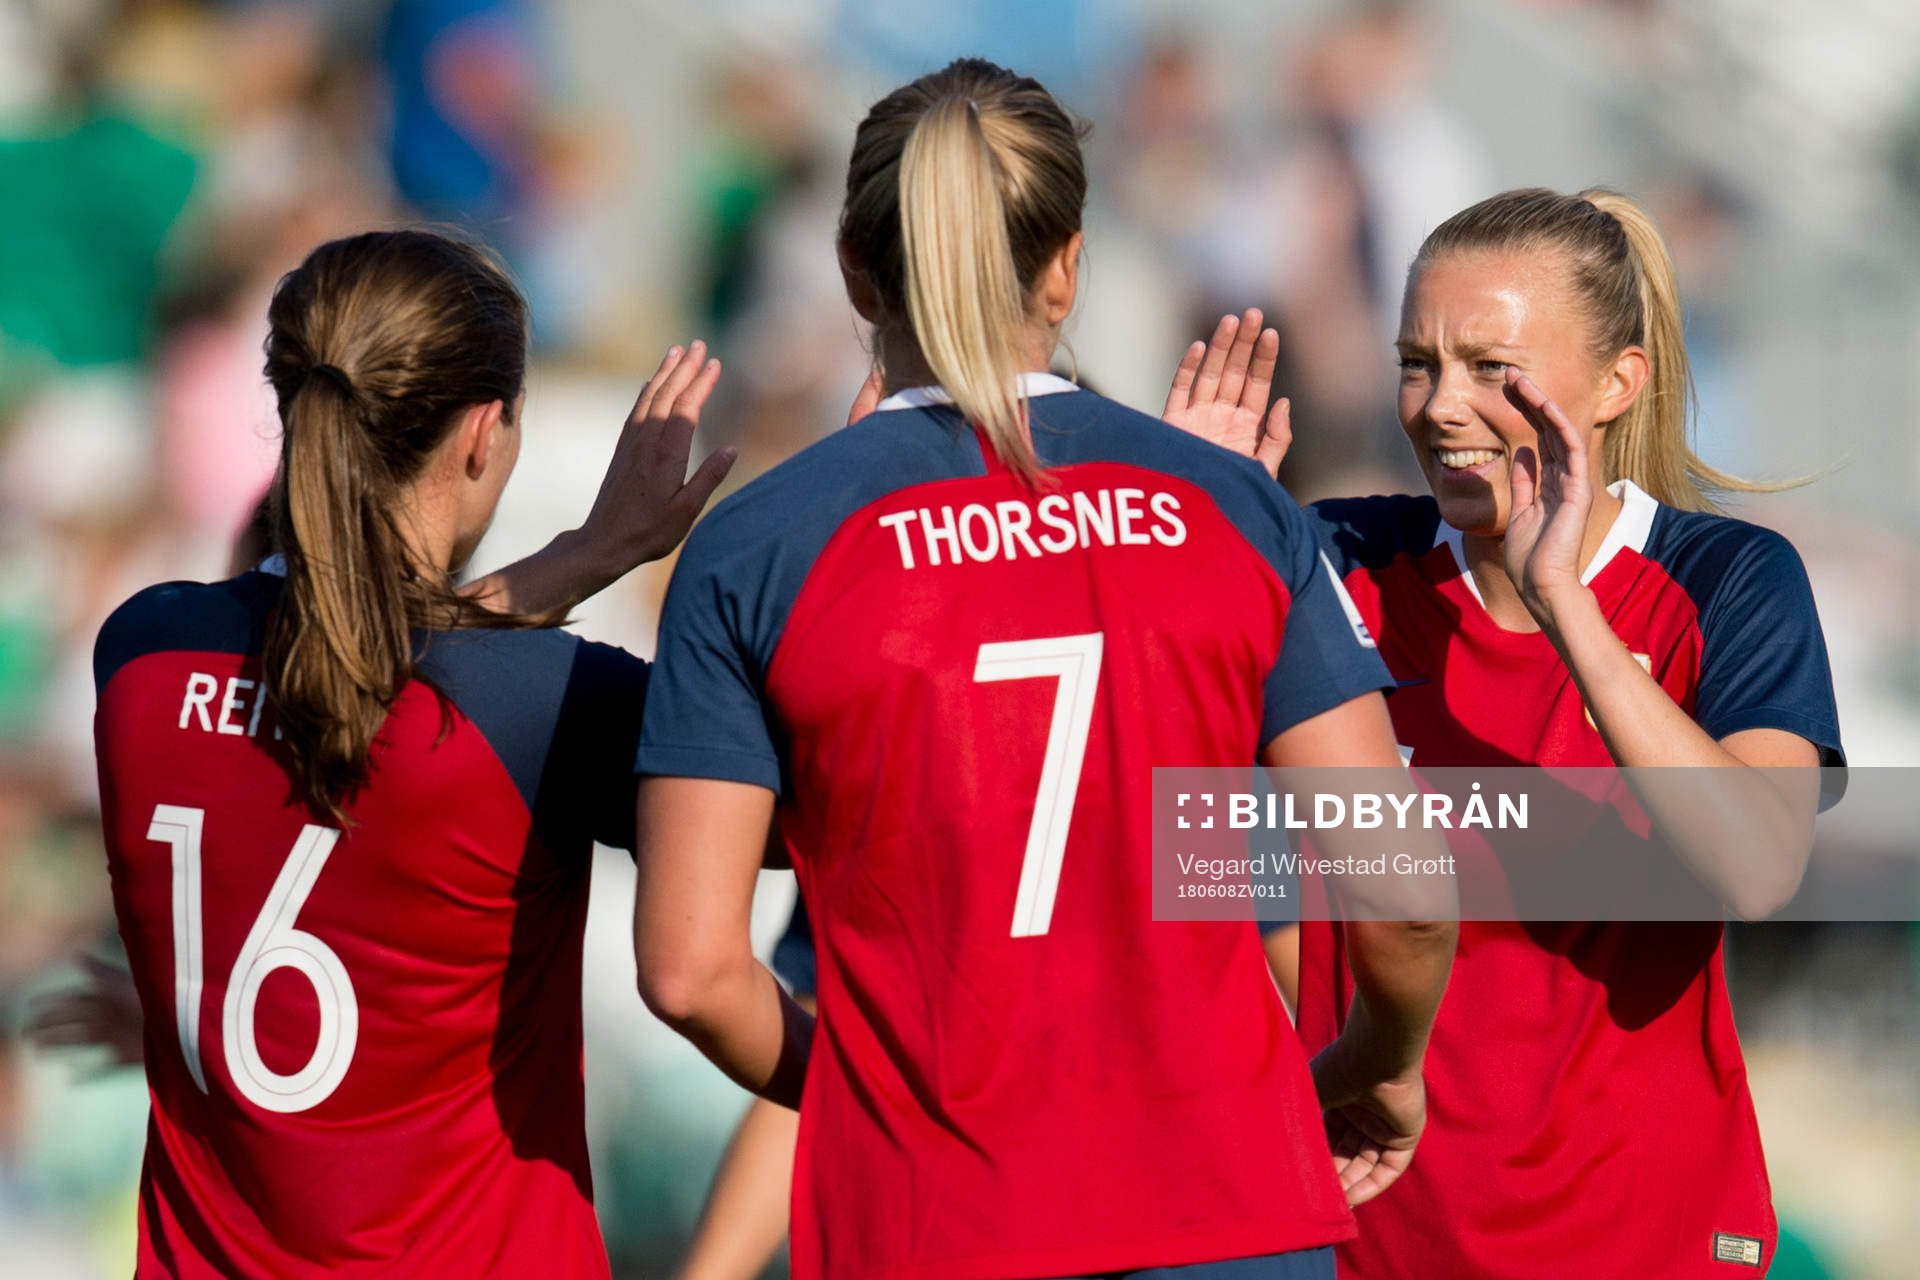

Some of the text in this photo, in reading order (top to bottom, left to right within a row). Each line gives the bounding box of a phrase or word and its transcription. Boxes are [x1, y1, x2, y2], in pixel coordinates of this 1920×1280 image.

[879, 488, 1187, 570] THORSNES
[178, 671, 283, 741] REI
[973, 632, 1104, 938] 7
[146, 804, 359, 1113] 16
